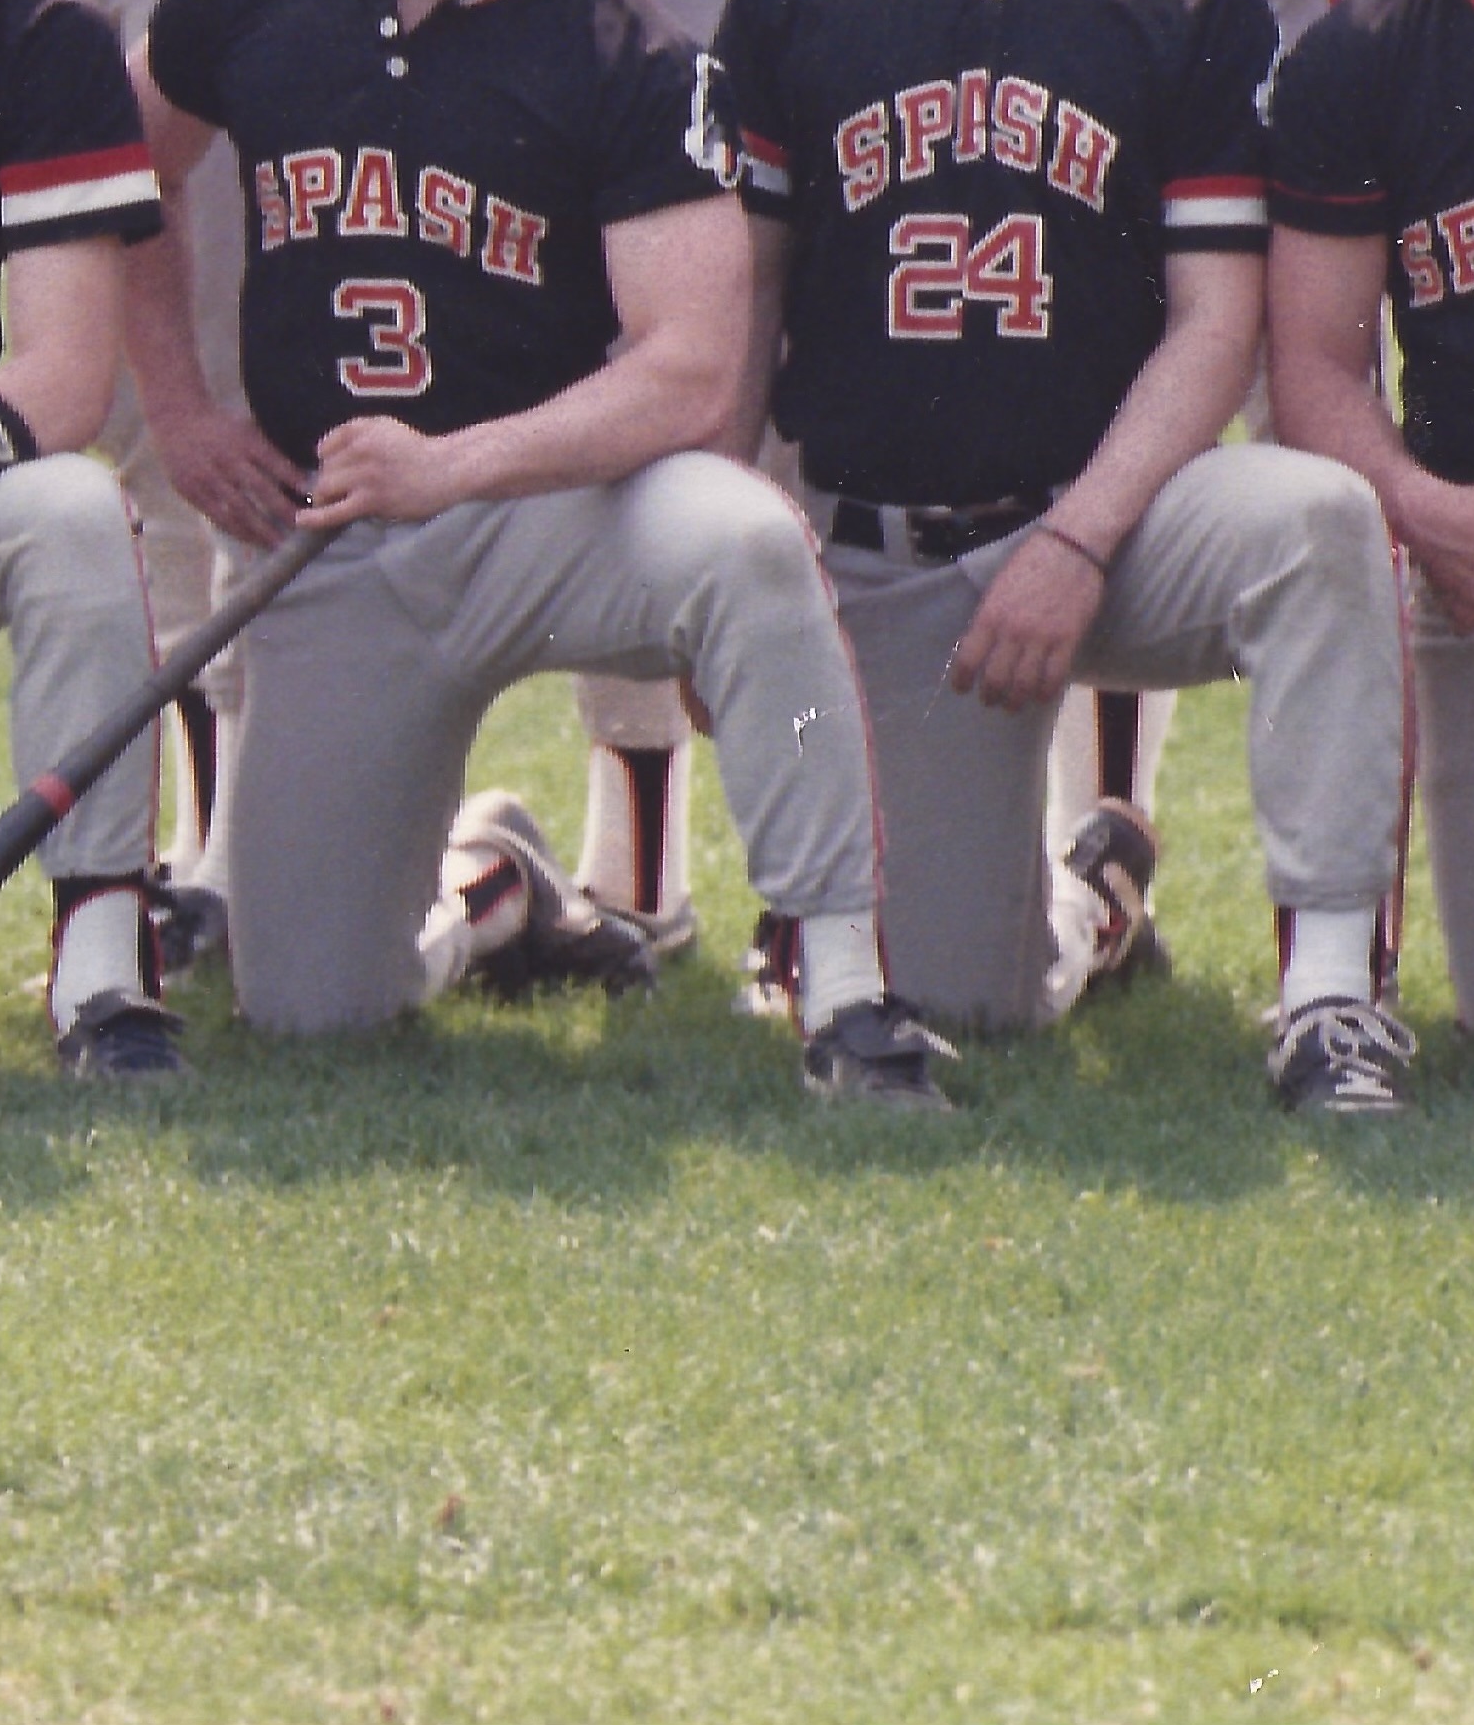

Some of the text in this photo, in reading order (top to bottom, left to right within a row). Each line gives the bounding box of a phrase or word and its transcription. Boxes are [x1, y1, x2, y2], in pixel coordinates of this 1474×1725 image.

[836, 67, 1118, 213] SPASH
[334, 278, 431, 398] 3
[888, 213, 1053, 339] 24
